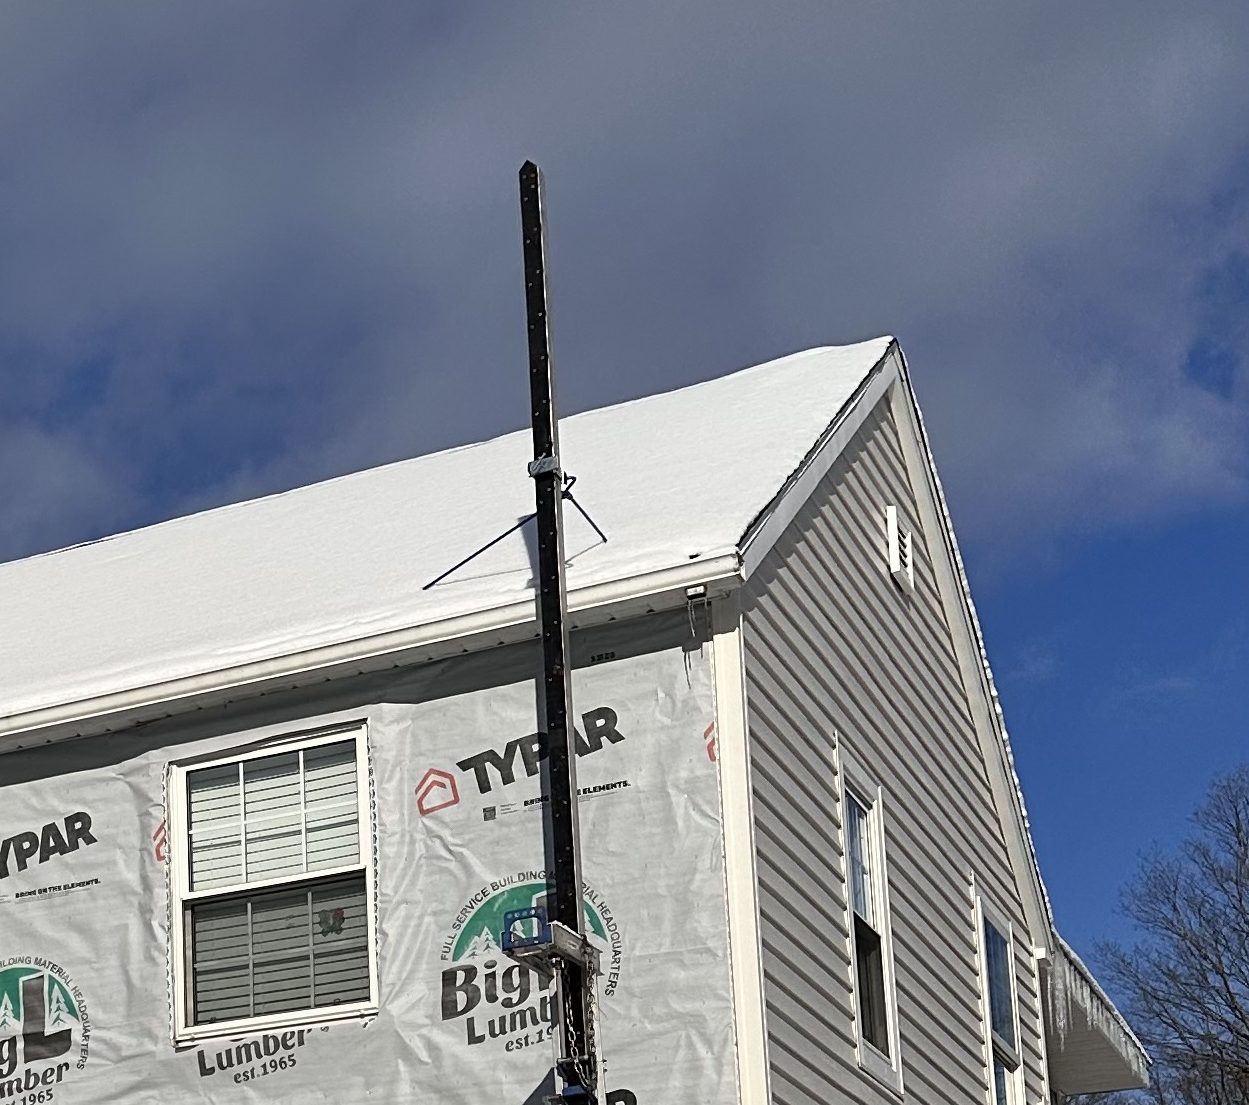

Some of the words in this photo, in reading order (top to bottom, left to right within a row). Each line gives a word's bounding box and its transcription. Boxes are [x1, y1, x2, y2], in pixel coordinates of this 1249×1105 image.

[456, 707, 625, 794] TYPR
[441, 932, 457, 960] FULL
[452, 887, 491, 930] SERVICE
[491, 870, 547, 891] BUILDING
[599, 901, 621, 997] HEADQUARTERS
[34, 957, 72, 988] MATERIAL
[71, 985, 91, 1070] HEADQUARTERS
[441, 959, 531, 1021] Big
[466, 995, 551, 1045] Lumb
